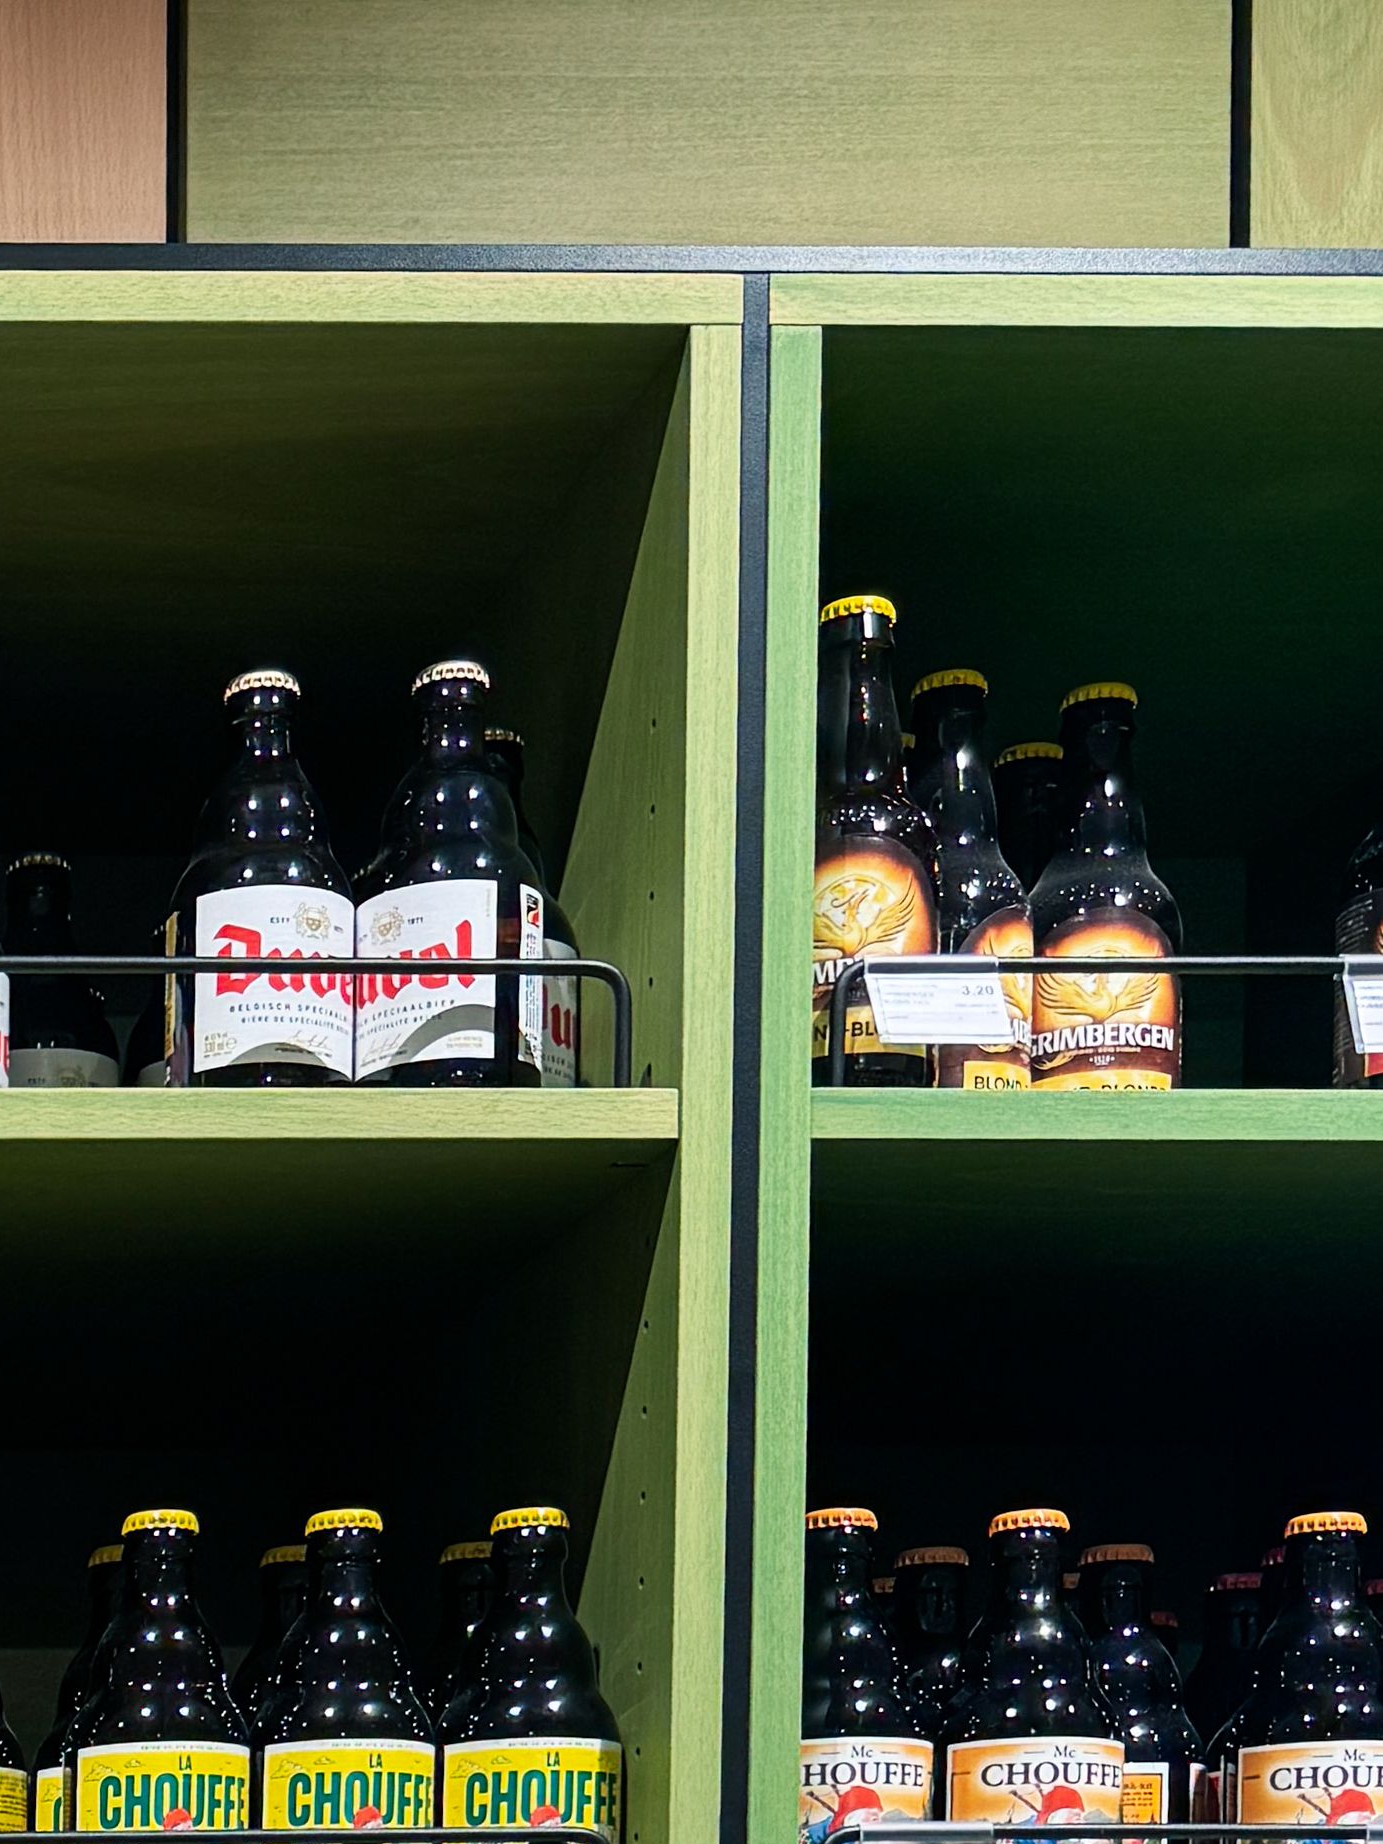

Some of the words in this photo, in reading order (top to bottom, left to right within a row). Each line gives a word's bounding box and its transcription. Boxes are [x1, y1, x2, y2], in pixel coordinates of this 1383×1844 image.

[546, 1751, 561, 1768] LA
[851, 1744, 873, 1759] Mc
[1053, 1743, 1077, 1759] Mc
[1343, 1747, 1367, 1763] Mc
[179, 1755, 193, 1772] LA
[368, 1752, 383, 1769] LA
[980, 1760, 1121, 1788] CHOUFFE
[99, 1772, 245, 1832] CHOUFFE
[465, 1769, 618, 1828] CHOUFFE
